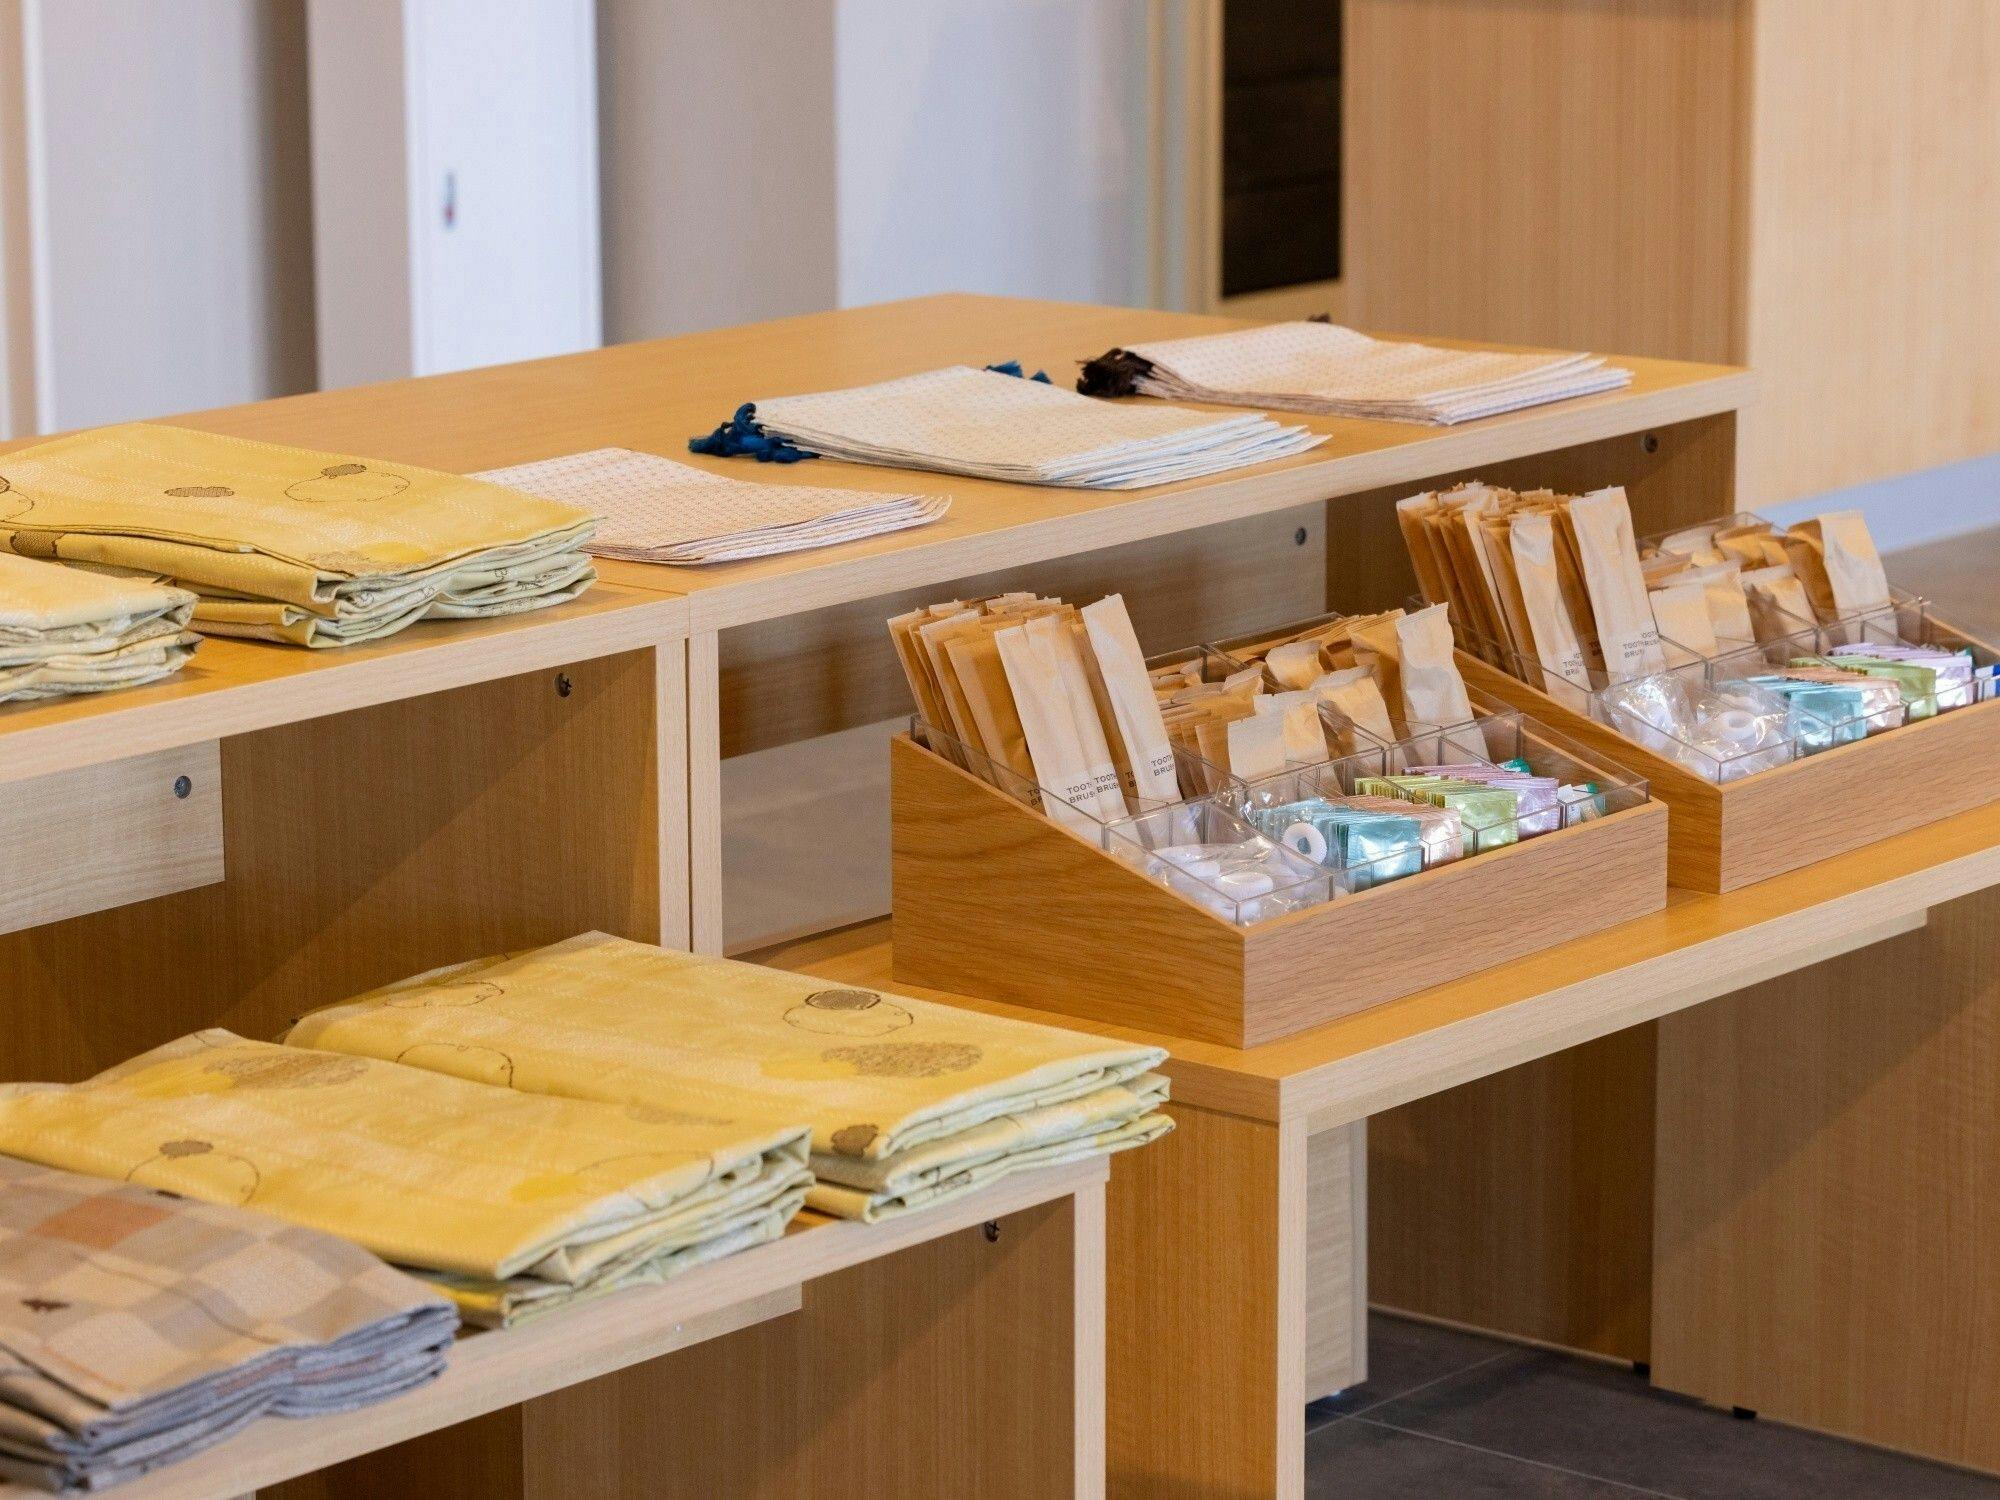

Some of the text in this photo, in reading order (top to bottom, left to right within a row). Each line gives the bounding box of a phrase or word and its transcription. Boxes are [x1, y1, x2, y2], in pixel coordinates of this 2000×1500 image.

[1153, 764, 1175, 777] BRUS
[1066, 782, 1092, 795] TOOT
[1097, 782, 1119, 794] BRUS
[1069, 791, 1095, 804] BRUS
